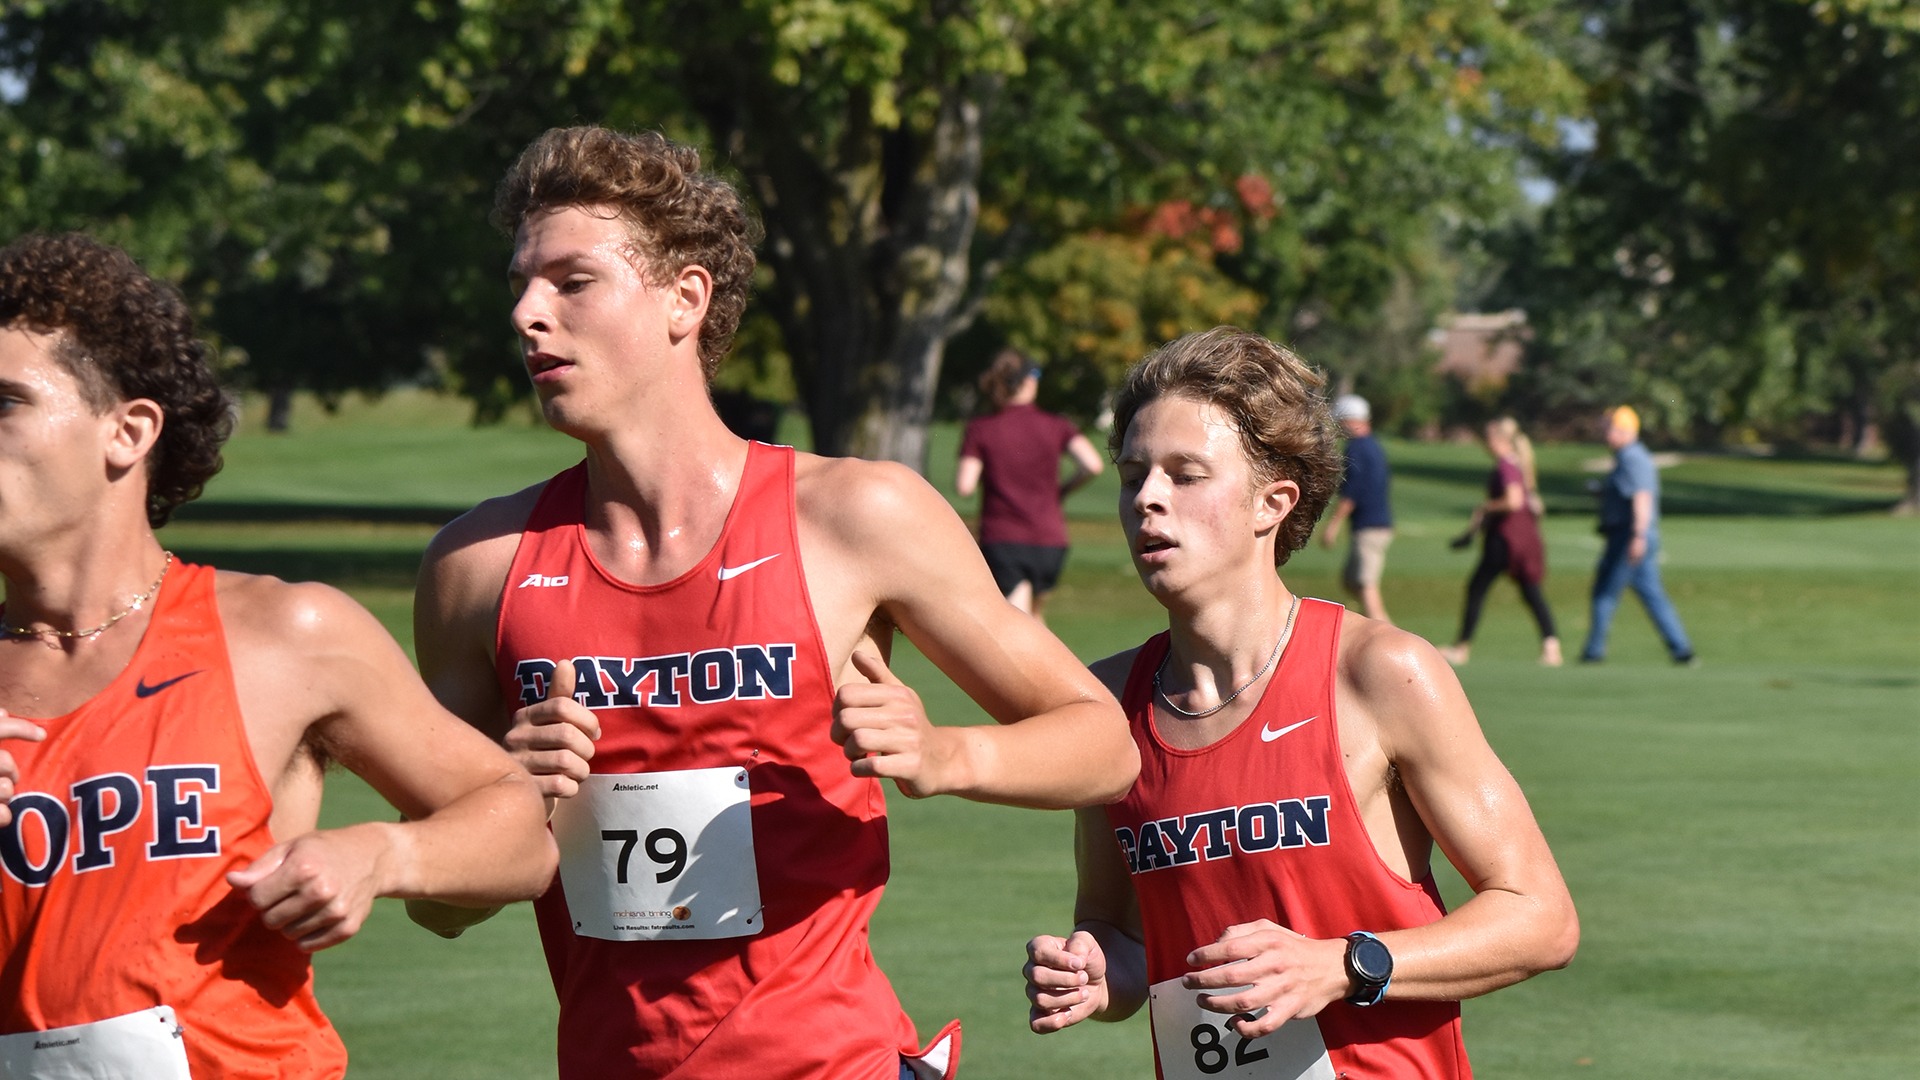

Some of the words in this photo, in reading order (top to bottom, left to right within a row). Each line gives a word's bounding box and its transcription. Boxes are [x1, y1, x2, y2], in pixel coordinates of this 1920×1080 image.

[518, 573, 570, 588] A10
[612, 782, 659, 792] Athletic.net
[0, 763, 222, 888] OPE
[601, 827, 688, 884] 79
[1190, 1012, 1270, 1075] 82
